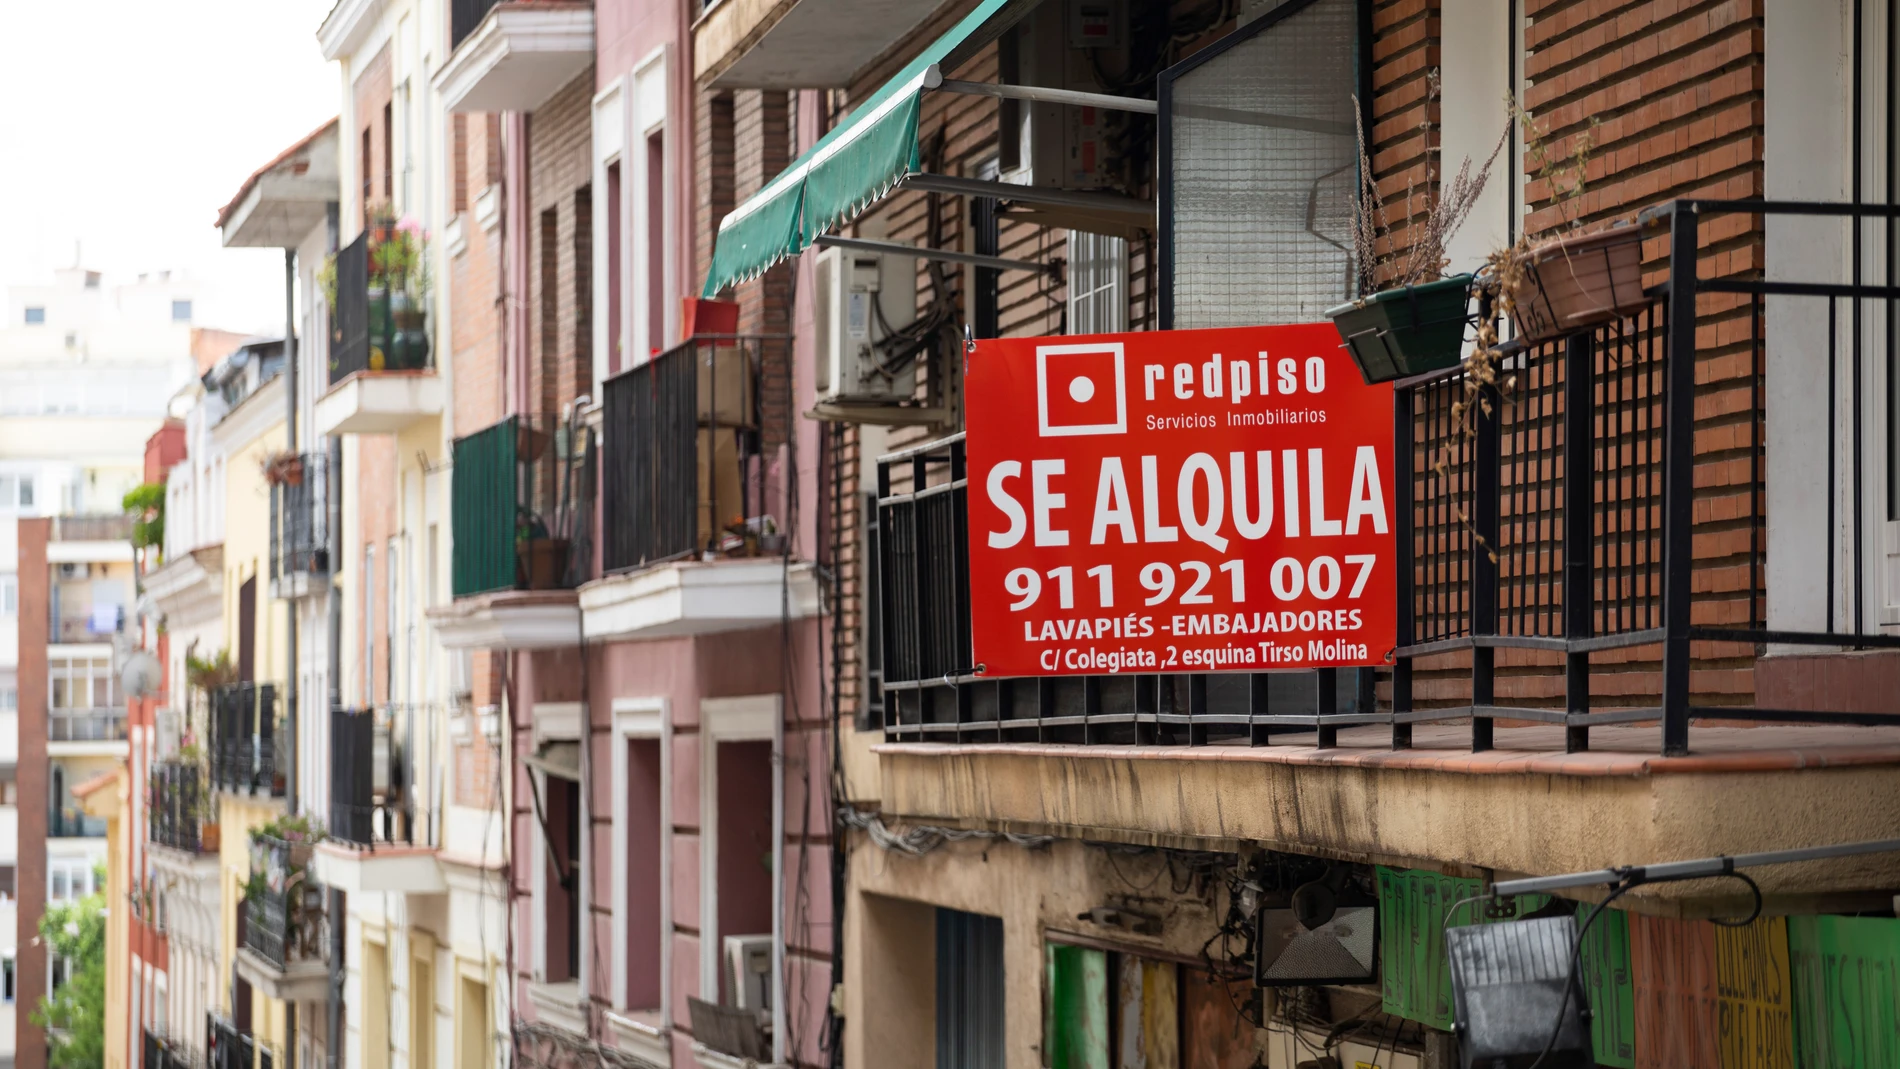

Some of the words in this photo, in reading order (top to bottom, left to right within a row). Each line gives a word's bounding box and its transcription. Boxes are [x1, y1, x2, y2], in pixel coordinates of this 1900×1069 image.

[1144, 350, 1326, 405] redpiso
[1146, 412, 1217, 431] Servicios
[1227, 408, 1327, 427] Inmobiliarios
[986, 458, 1070, 550] SE
[1089, 445, 1389, 554] ALQUILA
[1004, 564, 1114, 612] 911
[1138, 559, 1246, 607] 921
[1269, 553, 1377, 602] 007
[1024, 614, 1155, 642] LAVAPIÉS
[1040, 648, 1061, 671] C/
[1064, 645, 1157, 676] Colegiata
[1182, 642, 1256, 670] esquina
[1258, 640, 1304, 663] Tirso
[1307, 638, 1368, 662] Molina
